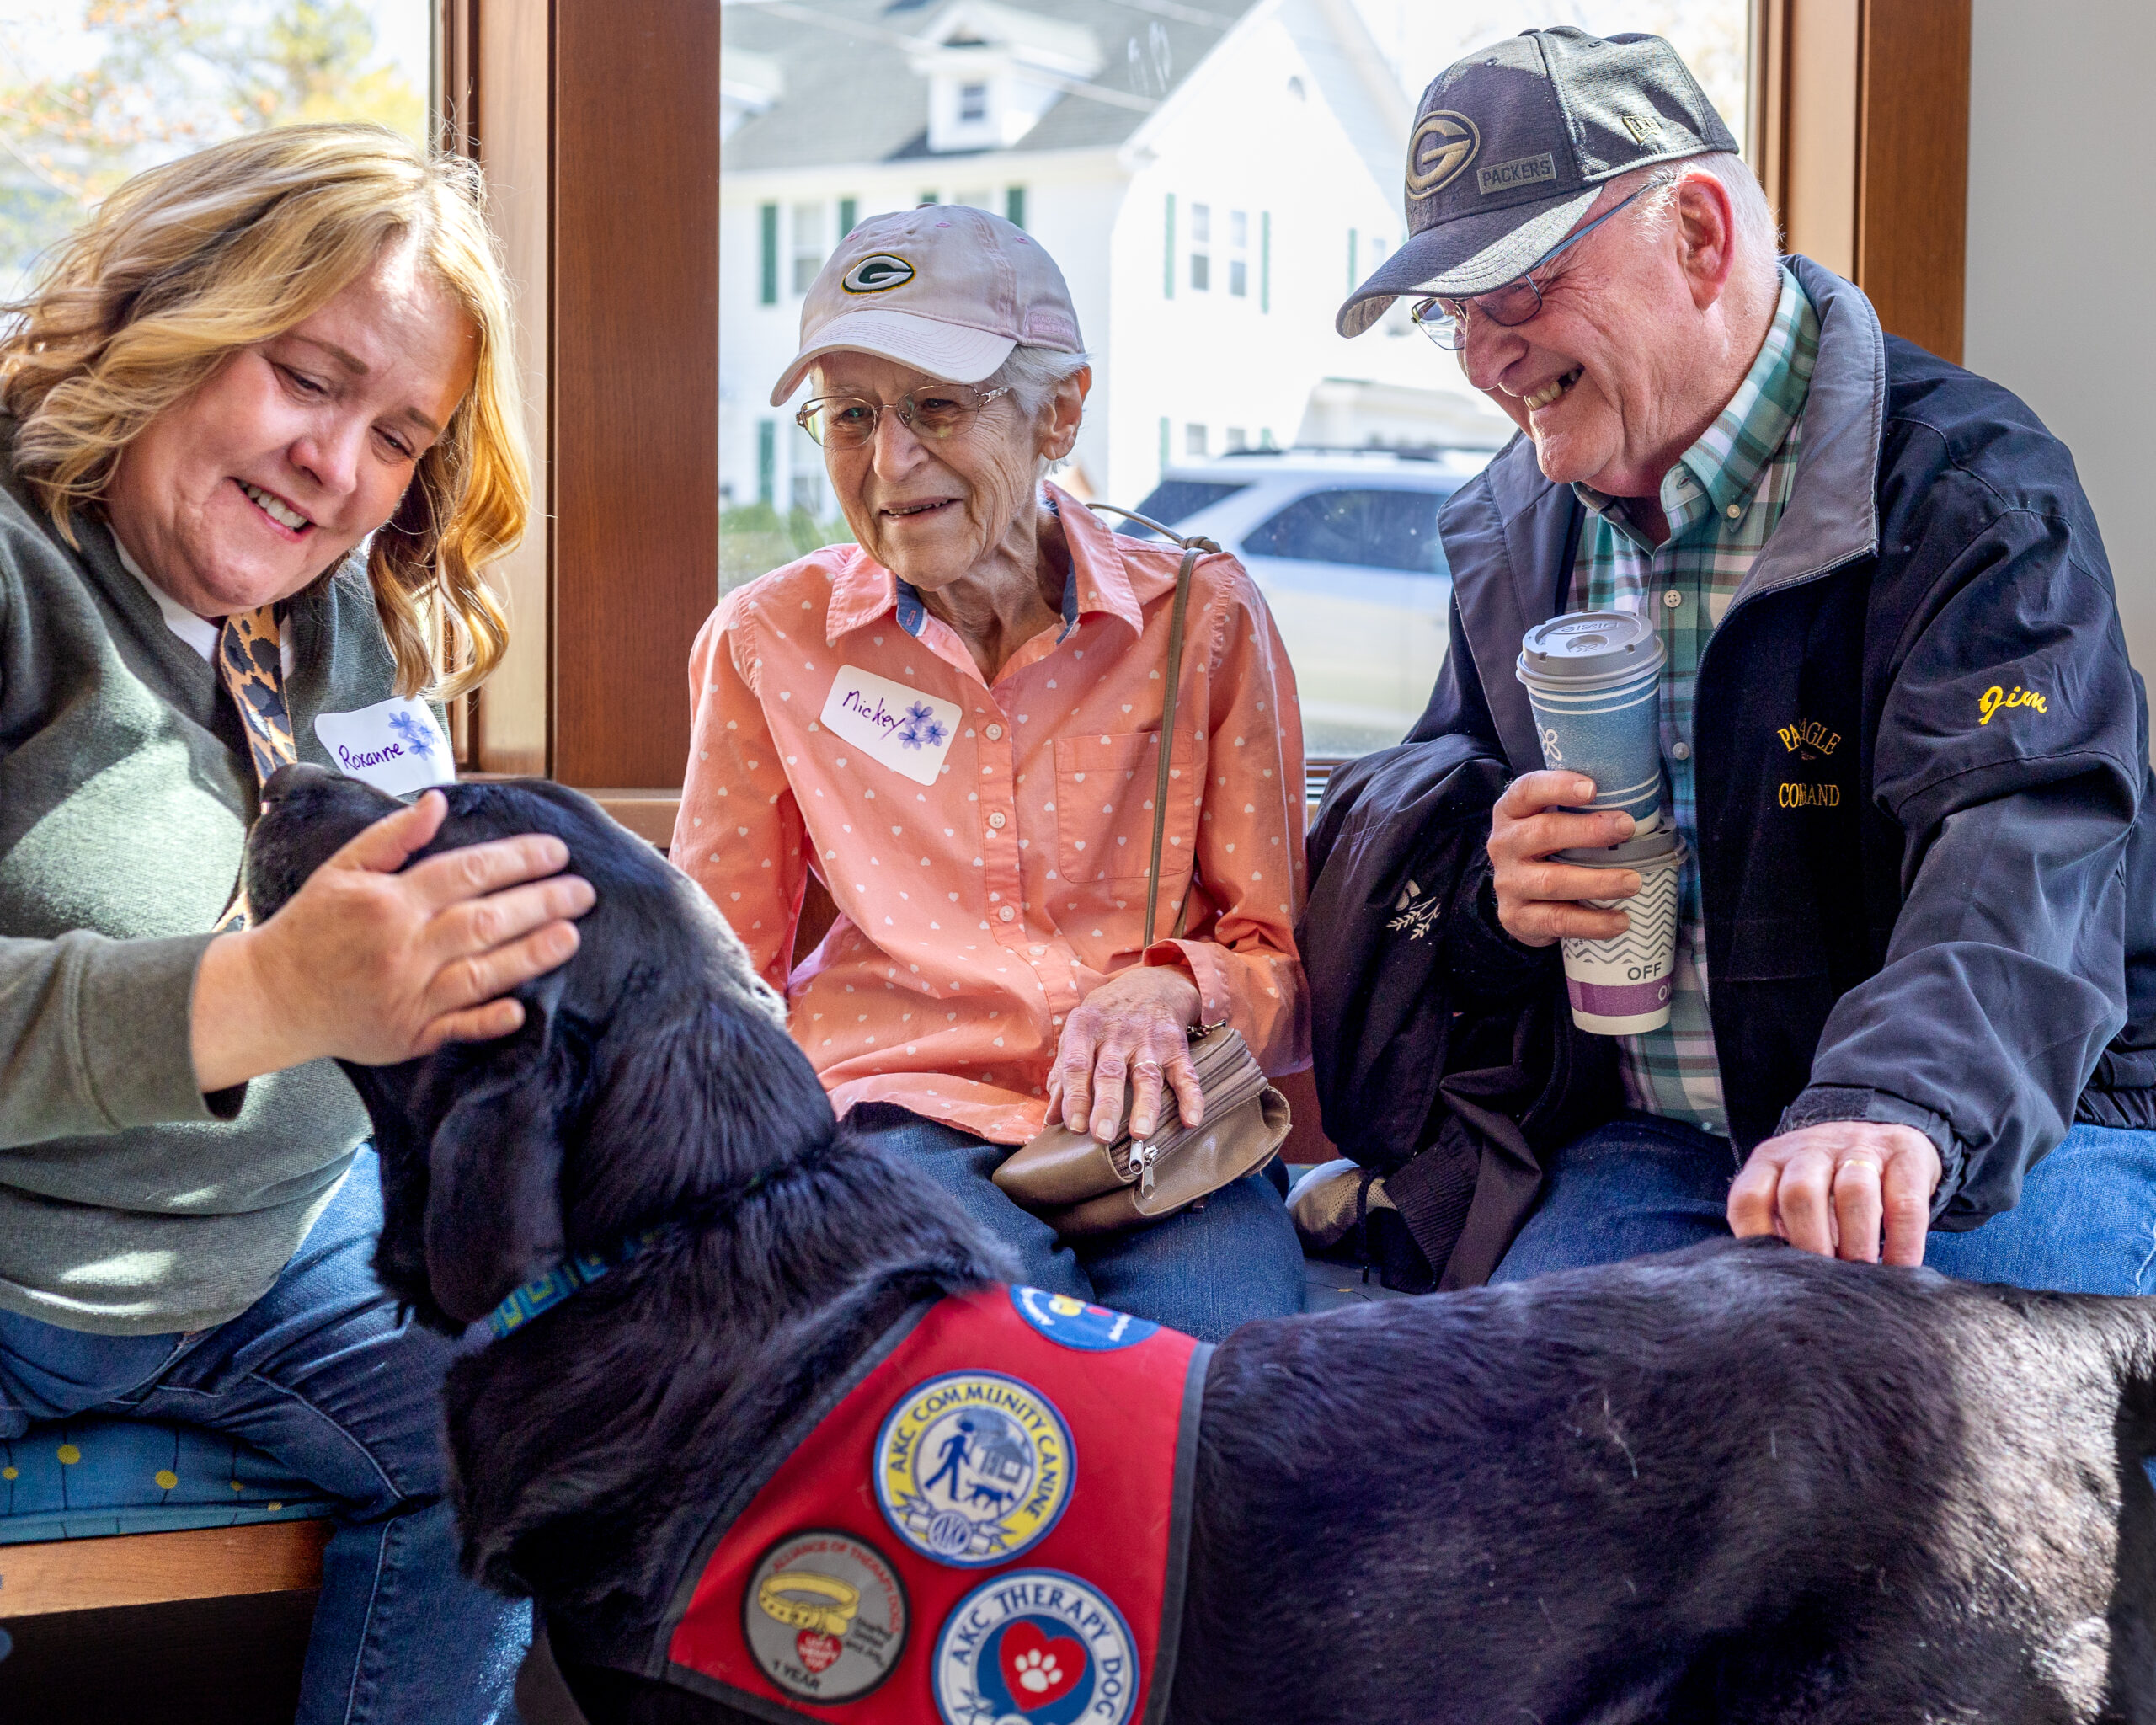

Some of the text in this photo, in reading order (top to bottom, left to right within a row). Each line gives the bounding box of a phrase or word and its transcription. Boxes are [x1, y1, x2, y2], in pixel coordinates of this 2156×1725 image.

[1481, 159, 1551, 186] PACKERS
[845, 255, 912, 291] G
[842, 690, 906, 741] Mickey
[1977, 686, 2047, 725] Jim
[339, 743, 405, 771] Roxanne
[1627, 962, 1662, 980] OFF
[890, 1386, 1058, 1520] AKC COMMUNITY CANINE
[952, 1610, 991, 1666] AKC
[993, 1584, 1112, 1642] THERAPY
[1095, 1658, 1122, 1719] DOG
[783, 1664, 820, 1690] YEAR
